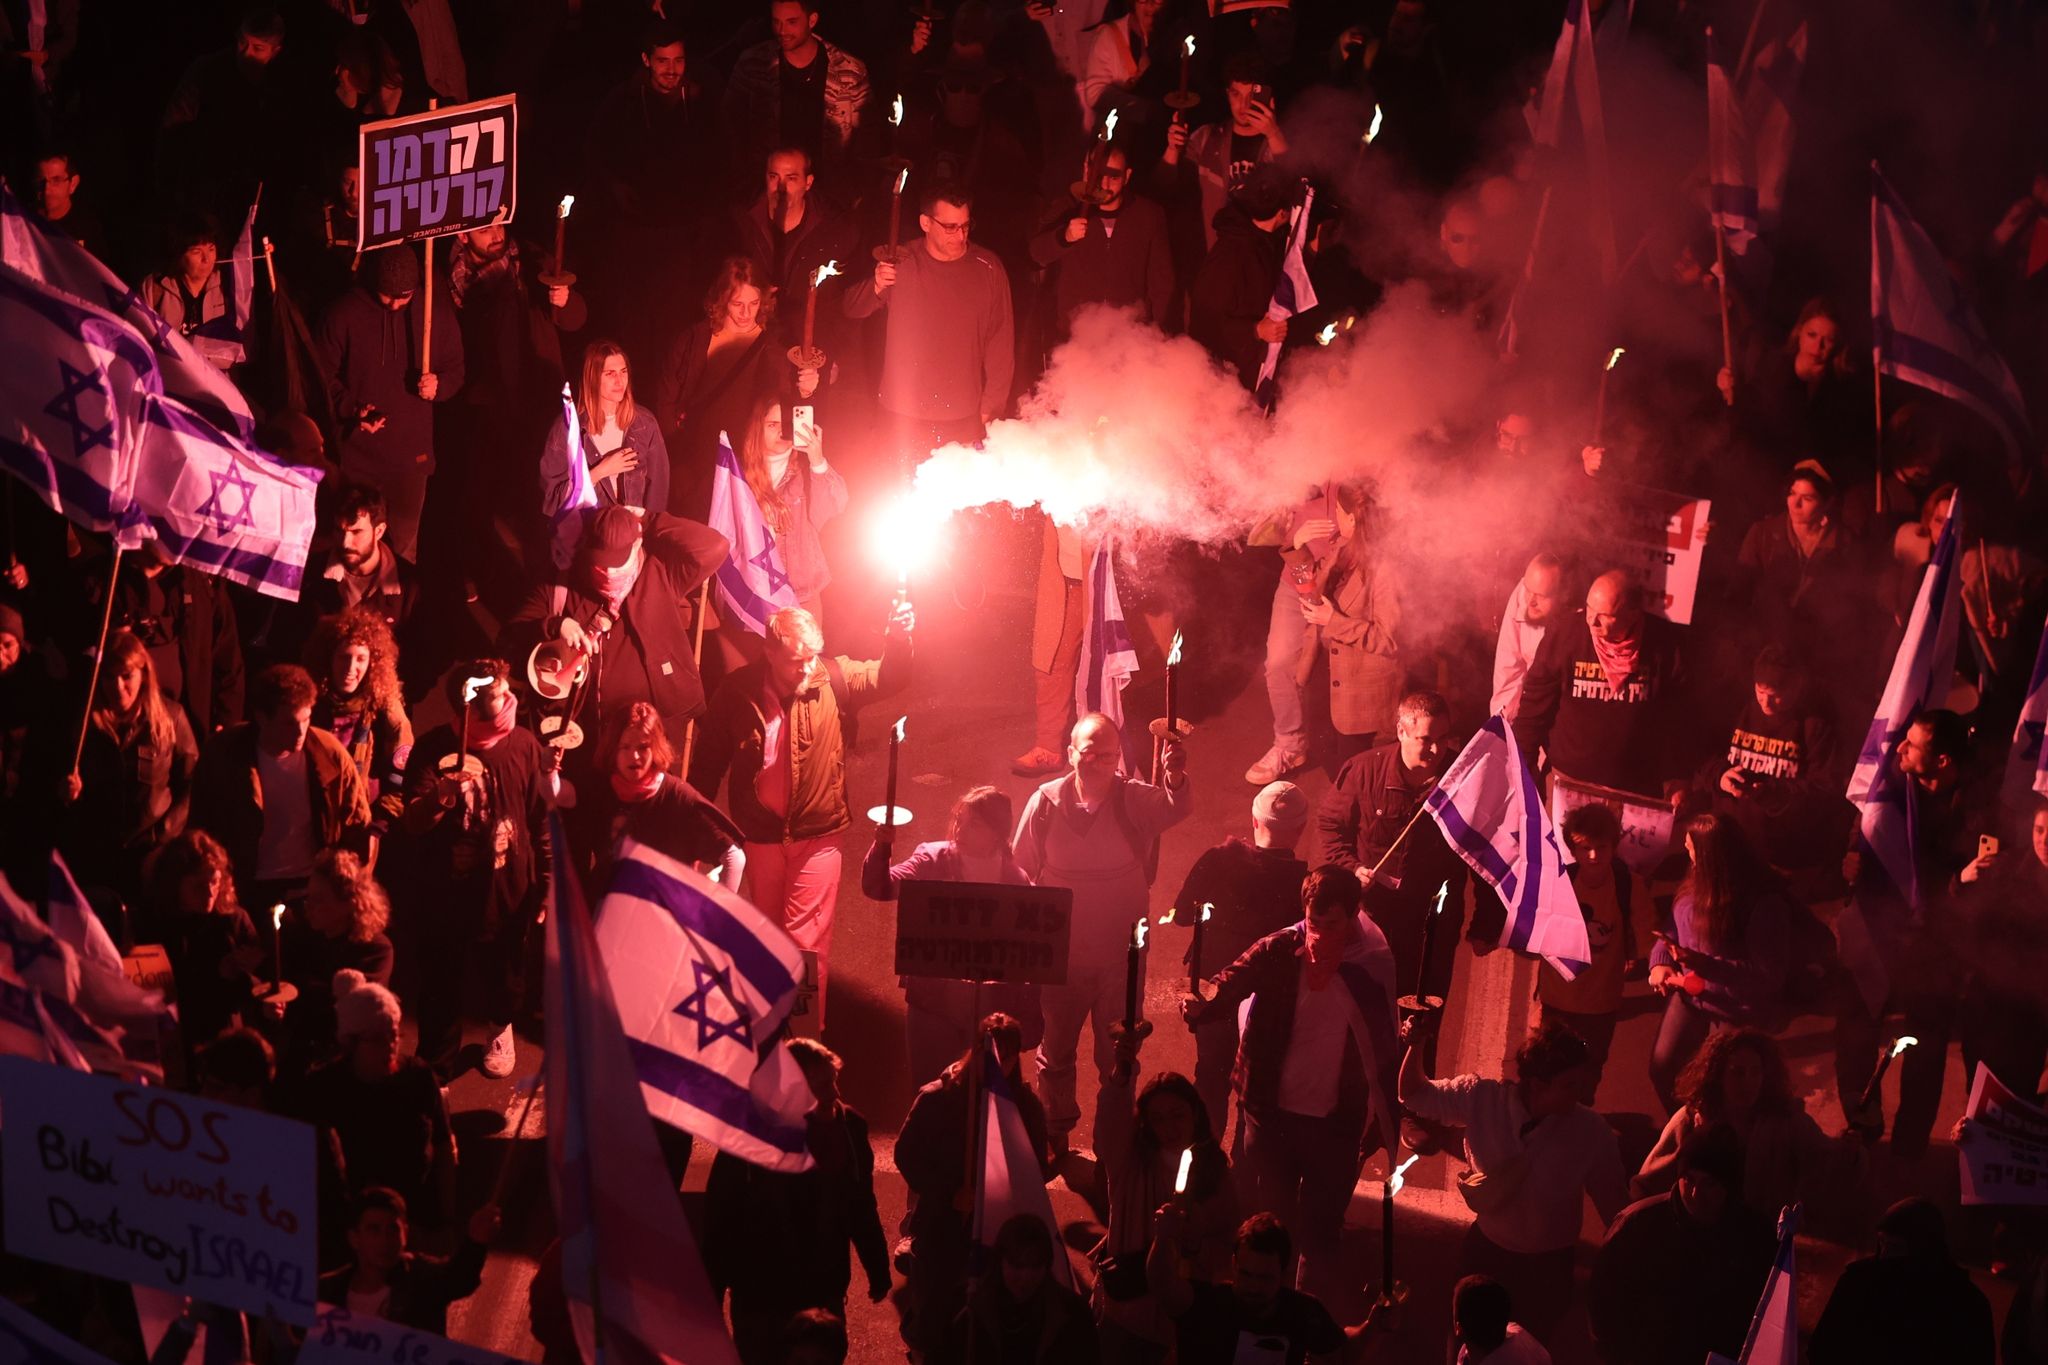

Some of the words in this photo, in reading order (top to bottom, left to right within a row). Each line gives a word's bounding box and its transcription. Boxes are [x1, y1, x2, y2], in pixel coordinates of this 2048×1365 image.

[373, 166, 505, 236] קרטיה
[114, 1090, 230, 1164] SOS
[37, 1124, 119, 1186] Bibi
[143, 1168, 249, 1217] wants
[256, 1184, 298, 1234] to
[47, 1196, 187, 1286] Destroy
[188, 1223, 316, 1309] ISRAEL
